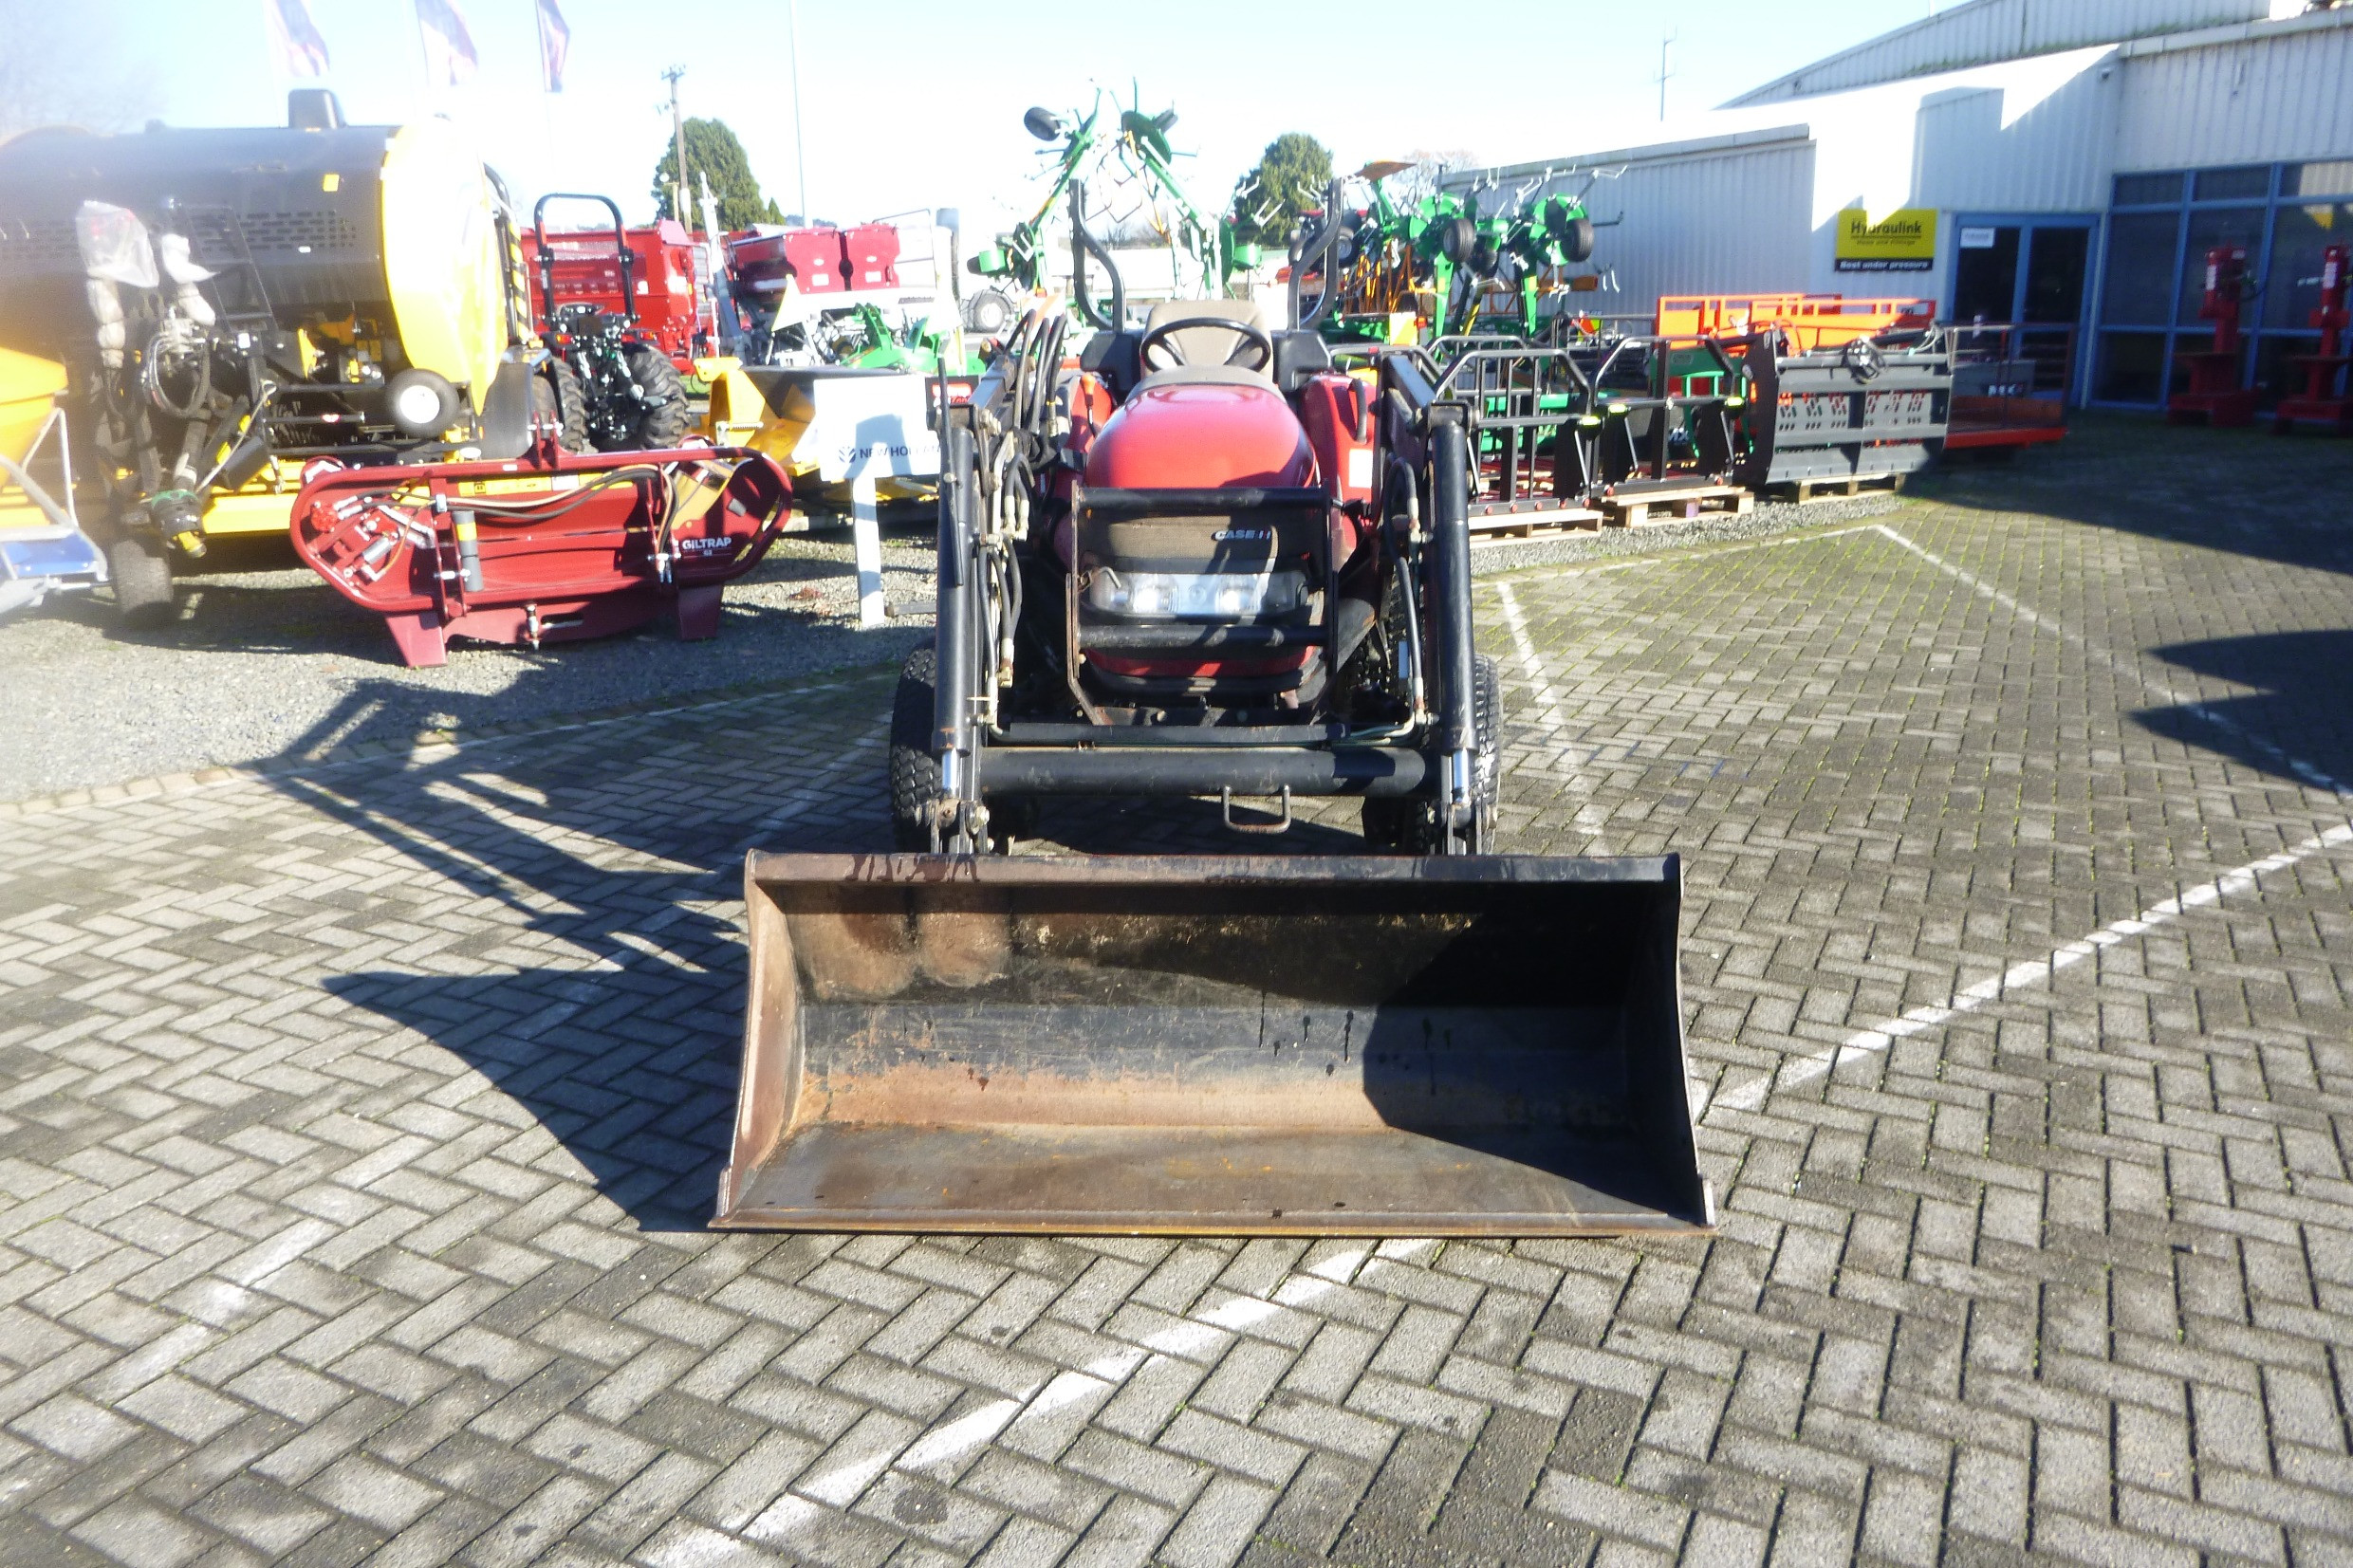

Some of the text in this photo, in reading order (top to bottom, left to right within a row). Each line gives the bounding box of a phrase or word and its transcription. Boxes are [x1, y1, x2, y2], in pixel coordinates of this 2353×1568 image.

[1850, 220, 1921, 235] Hydraulink
[1840, 260, 1929, 270] Best under pressure
[1214, 530, 1255, 541] CASE
[682, 536, 732, 550] GILTRAP
